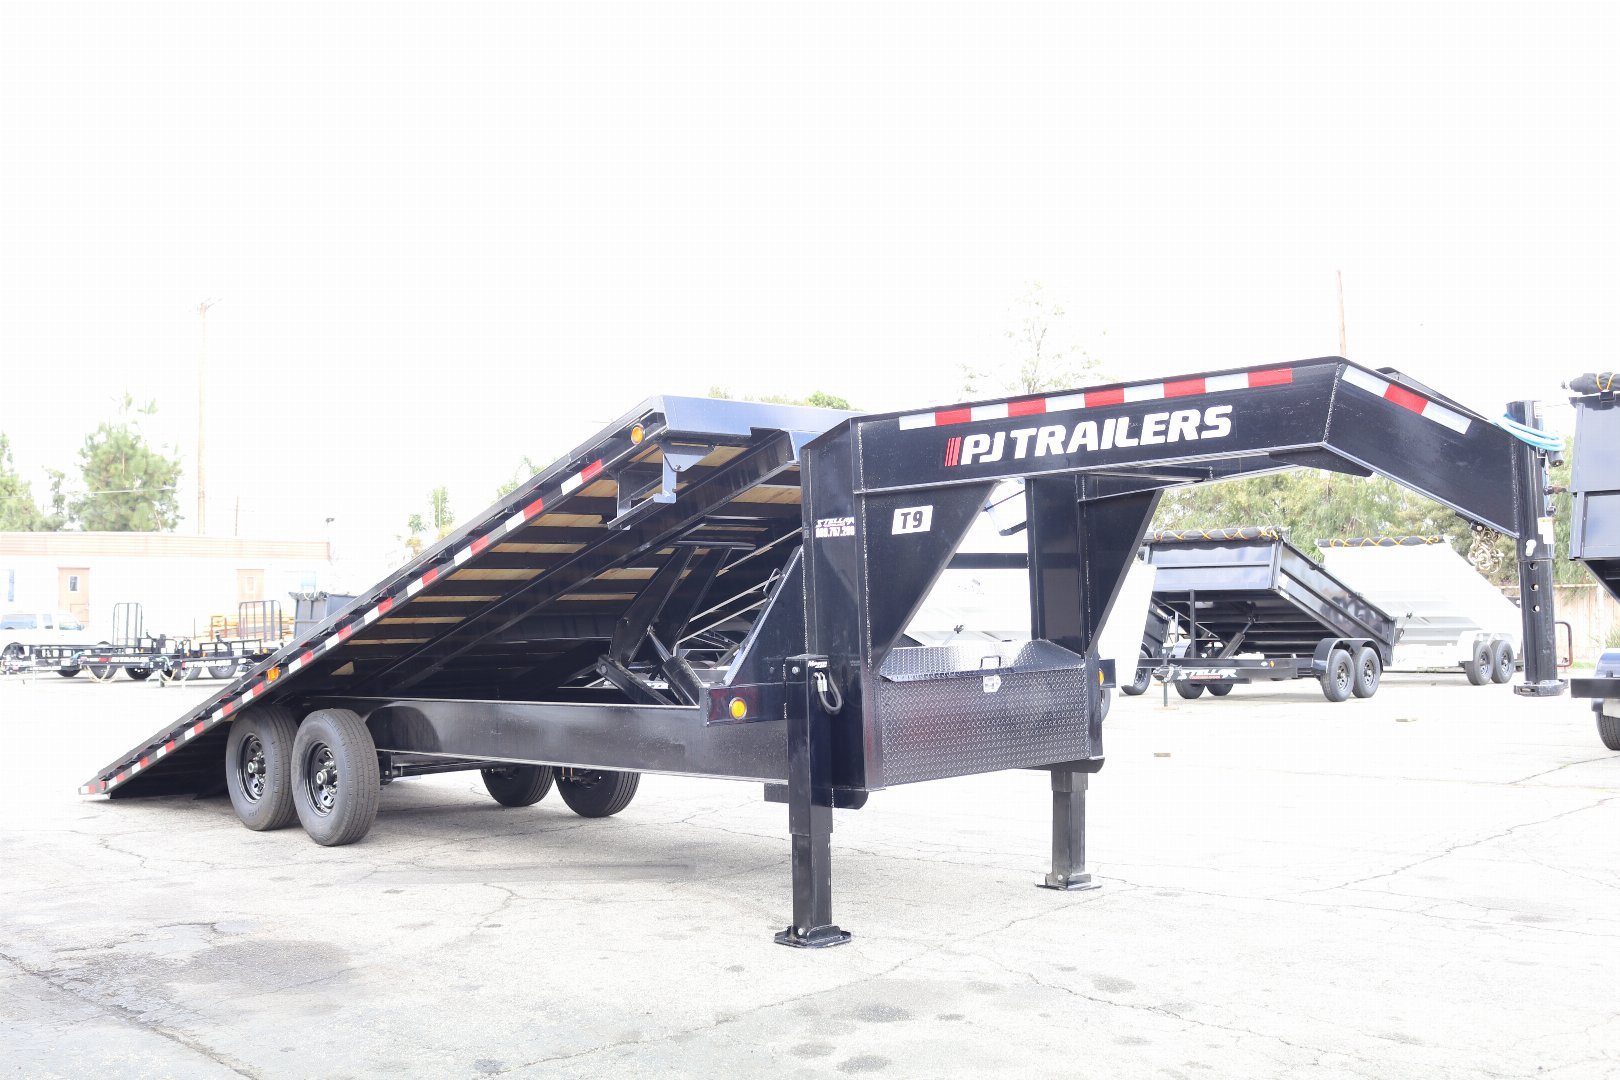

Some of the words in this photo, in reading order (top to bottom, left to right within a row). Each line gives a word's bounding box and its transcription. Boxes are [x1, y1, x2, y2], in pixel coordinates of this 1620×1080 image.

[961, 431, 1006, 466] PJ
[1009, 404, 1233, 460] TRAILERS
[900, 510, 924, 530] T9
